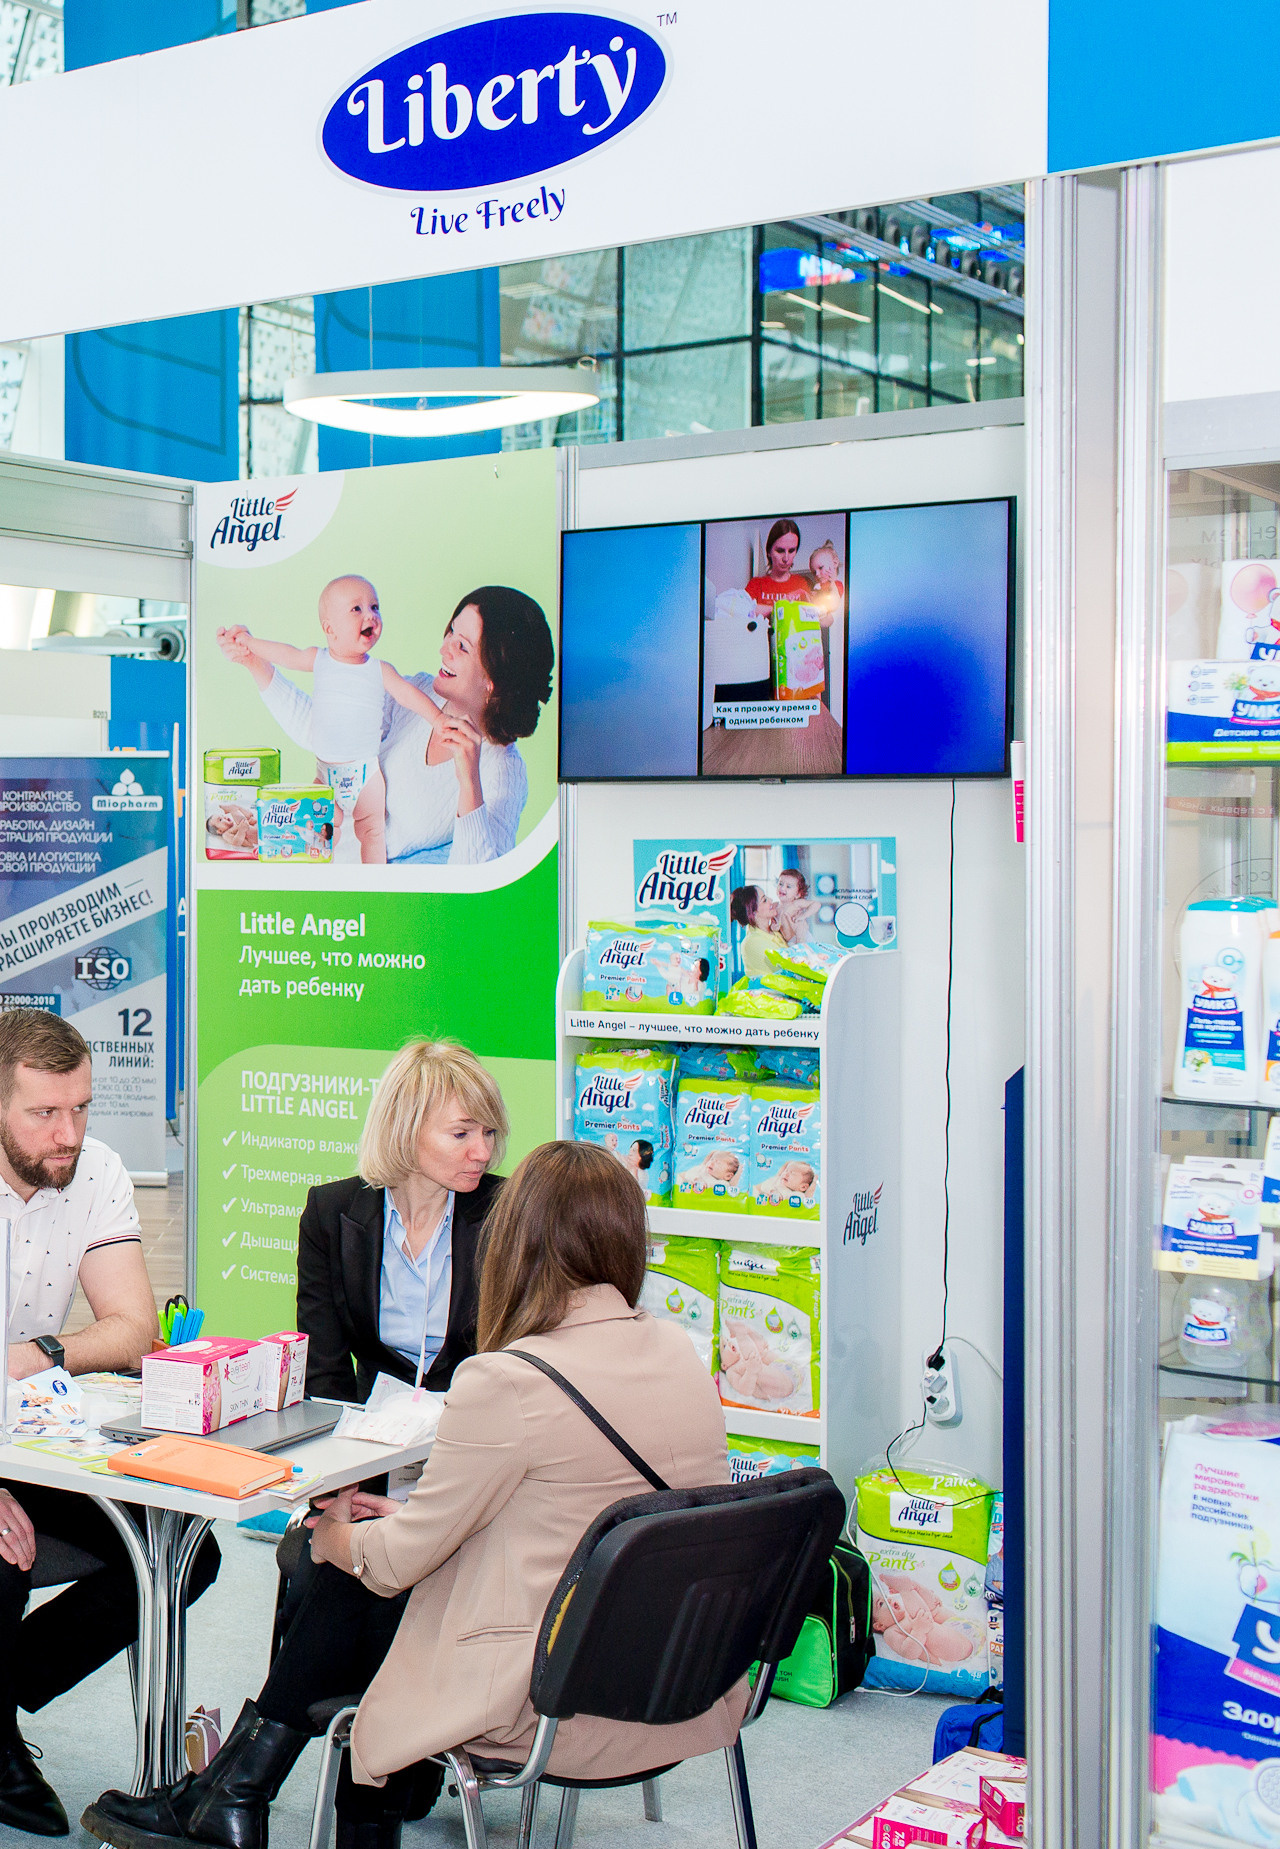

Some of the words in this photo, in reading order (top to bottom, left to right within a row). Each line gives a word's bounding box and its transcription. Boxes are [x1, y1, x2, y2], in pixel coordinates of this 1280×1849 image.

[346, 36, 638, 154] Liberty
[410, 206, 469, 235] Live
[476, 186, 566, 230] Freely
[230, 497, 275, 523] Little
[210, 514, 283, 552] Angel
[716, 705, 732, 713] Как
[740, 705, 780, 714] провожу
[781, 704, 810, 713] время
[728, 717, 758, 726] одним
[759, 716, 804, 725] ребенком
[2, 791, 74, 801] КОНТРАКТНОЕ
[97, 798, 158, 811] Miopharm
[270, 803, 290, 814] Little
[49, 818, 95, 832] ДИЗАЙН
[262, 812, 295, 827] Angel
[45, 832, 113, 844] ПРОДУКЦИИ
[29, 852, 38, 862] И
[37, 852, 102, 863] ЛОГИСТИКА
[659, 853, 708, 881] Little
[30, 862, 96, 874] ПРОДУКЦИИ
[638, 872, 718, 909] Angel
[18, 882, 122, 941] ПРОИЗВОДИМ
[91, 889, 154, 929] БИЗНЕС!
[239, 911, 295, 935] Little
[301, 913, 366, 942] Angel
[238, 945, 316, 969] Лучшее,
[320, 950, 353, 967] что
[357, 953, 426, 969] можно
[612, 940, 639, 955] Little
[599, 948, 644, 969] Angel
[76, 957, 130, 980] ISO
[626, 975, 646, 983] Pants
[238, 978, 281, 996] дать
[286, 977, 365, 1002] ребенку
[4, 995, 56, 1005] 22000:2018
[118, 1008, 153, 1037] 12
[570, 1018, 596, 1029] Little
[597, 1019, 627, 1032] Angel
[637, 1023, 682, 1035] лучшее,
[685, 1025, 703, 1034] что
[705, 1027, 742, 1036] можно
[744, 1028, 771, 1038] дать
[773, 1027, 820, 1041] ребенку
[86, 1041, 155, 1054] ДСТВЕННЫХ
[108, 1055, 155, 1068] ЛИНИЙ:
[241, 1070, 380, 1096] ПОДГУЗНИКИ-Т
[593, 1075, 625, 1093] Little
[241, 1094, 296, 1116] LITTLE
[298, 1098, 359, 1120] ANGEL
[579, 1086, 631, 1113] Angel
[697, 1098, 726, 1113] Little
[684, 1107, 730, 1129] Angel
[769, 1106, 798, 1122] Little
[585, 1120, 616, 1129] Premier
[617, 1122, 640, 1131] Pants
[757, 1116, 803, 1138] Angel
[241, 1131, 315, 1154] Индикатор
[241, 1164, 322, 1187] Трехмерная
[240, 1198, 304, 1218] Ультрамя
[852, 1191, 874, 1215] Little
[843, 1210, 878, 1246] Angel
[240, 1232, 299, 1254] Дышащи
[240, 1265, 297, 1287] Система
[719, 1299, 756, 1319] Pants
[230, 1361, 251, 1376] everteen
[229, 1402, 239, 1413] SKIN
[239, 1399, 249, 1410] THIN
[730, 1457, 758, 1473] Little
[1195, 1463, 1240, 1478] Лучшие
[1194, 1474, 1245, 1489] мировые
[1194, 1483, 1260, 1502] разработки
[909, 1499, 935, 1511] Little
[1192, 1503, 1248, 1520] российских
[898, 1507, 939, 1526] Angel
[1191, 1512, 1254, 1531] подгузниках
[865, 1551, 918, 1571] Pants
[879, 1549, 900, 1557] extra
[901, 1549, 916, 1559] dry
[1222, 1701, 1280, 1735] Здор
